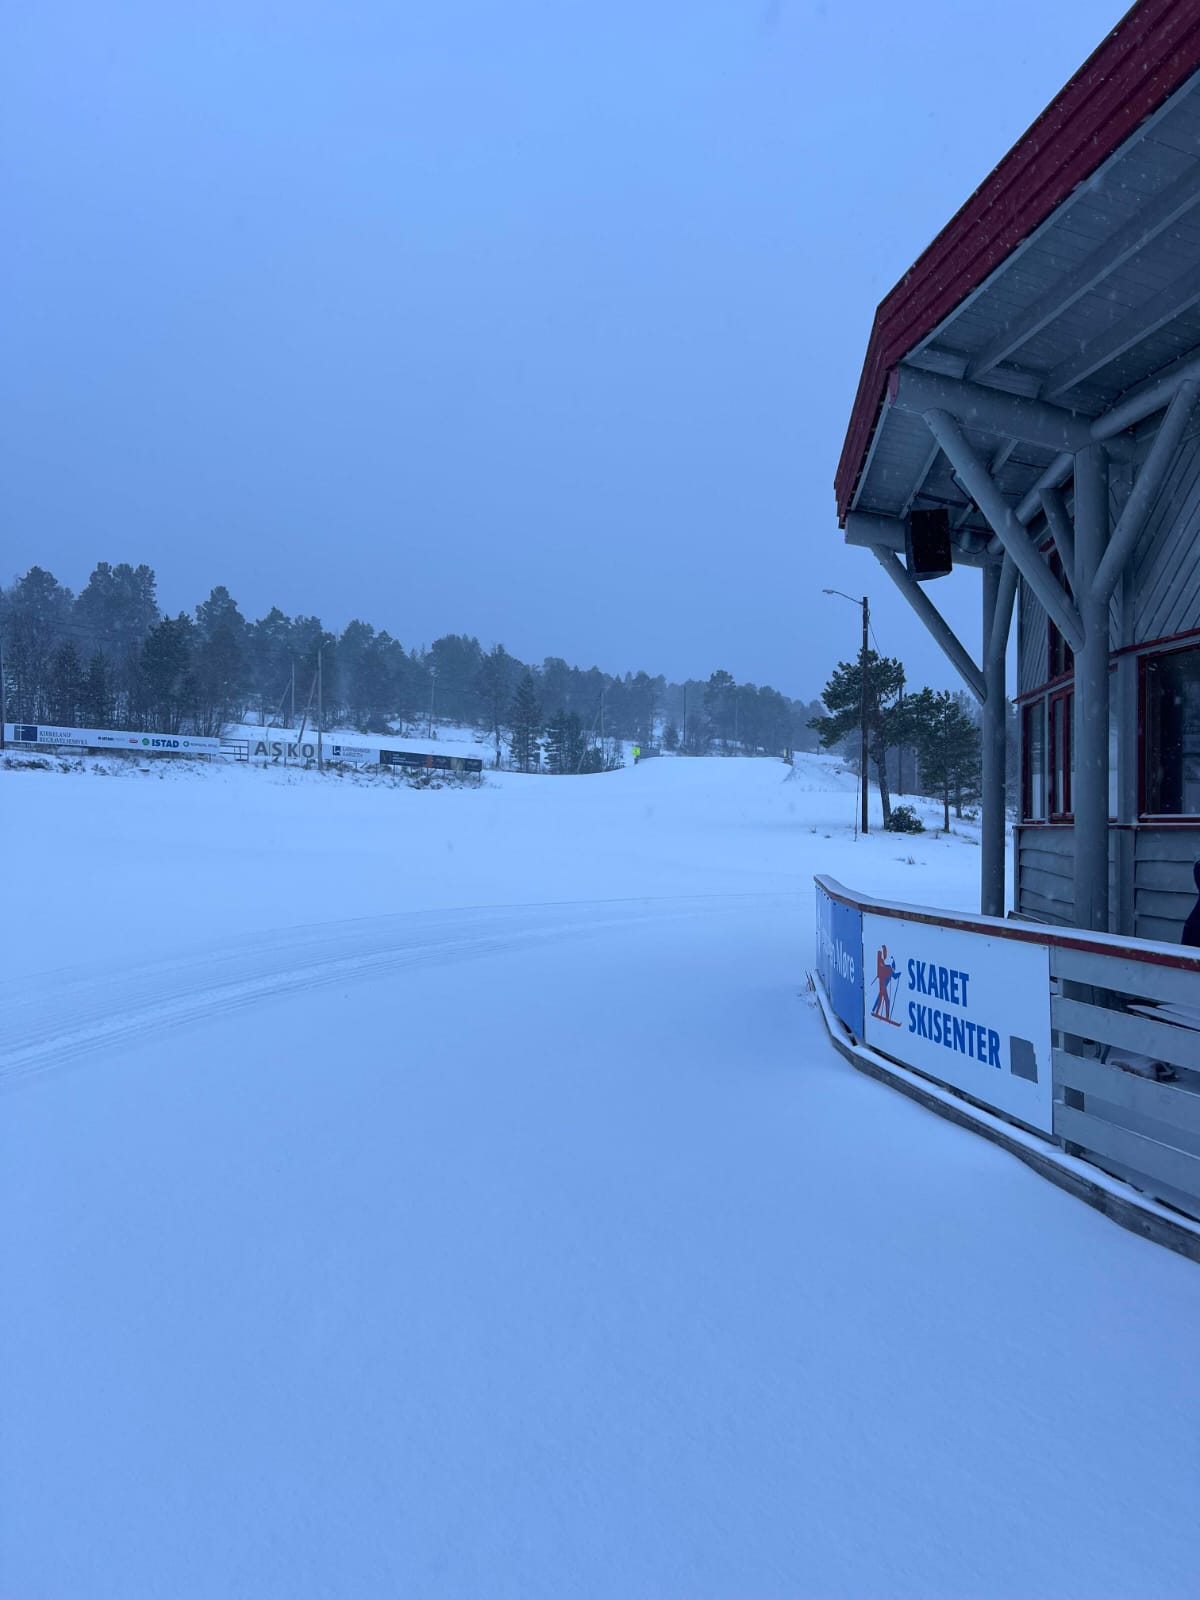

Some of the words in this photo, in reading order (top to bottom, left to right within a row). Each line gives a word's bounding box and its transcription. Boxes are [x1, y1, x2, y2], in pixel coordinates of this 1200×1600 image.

[151, 738, 179, 748] ISTAD
[254, 741, 315, 758] ASKO
[908, 958, 970, 1008] SKARET
[908, 1001, 1002, 1069] SKISENTER
